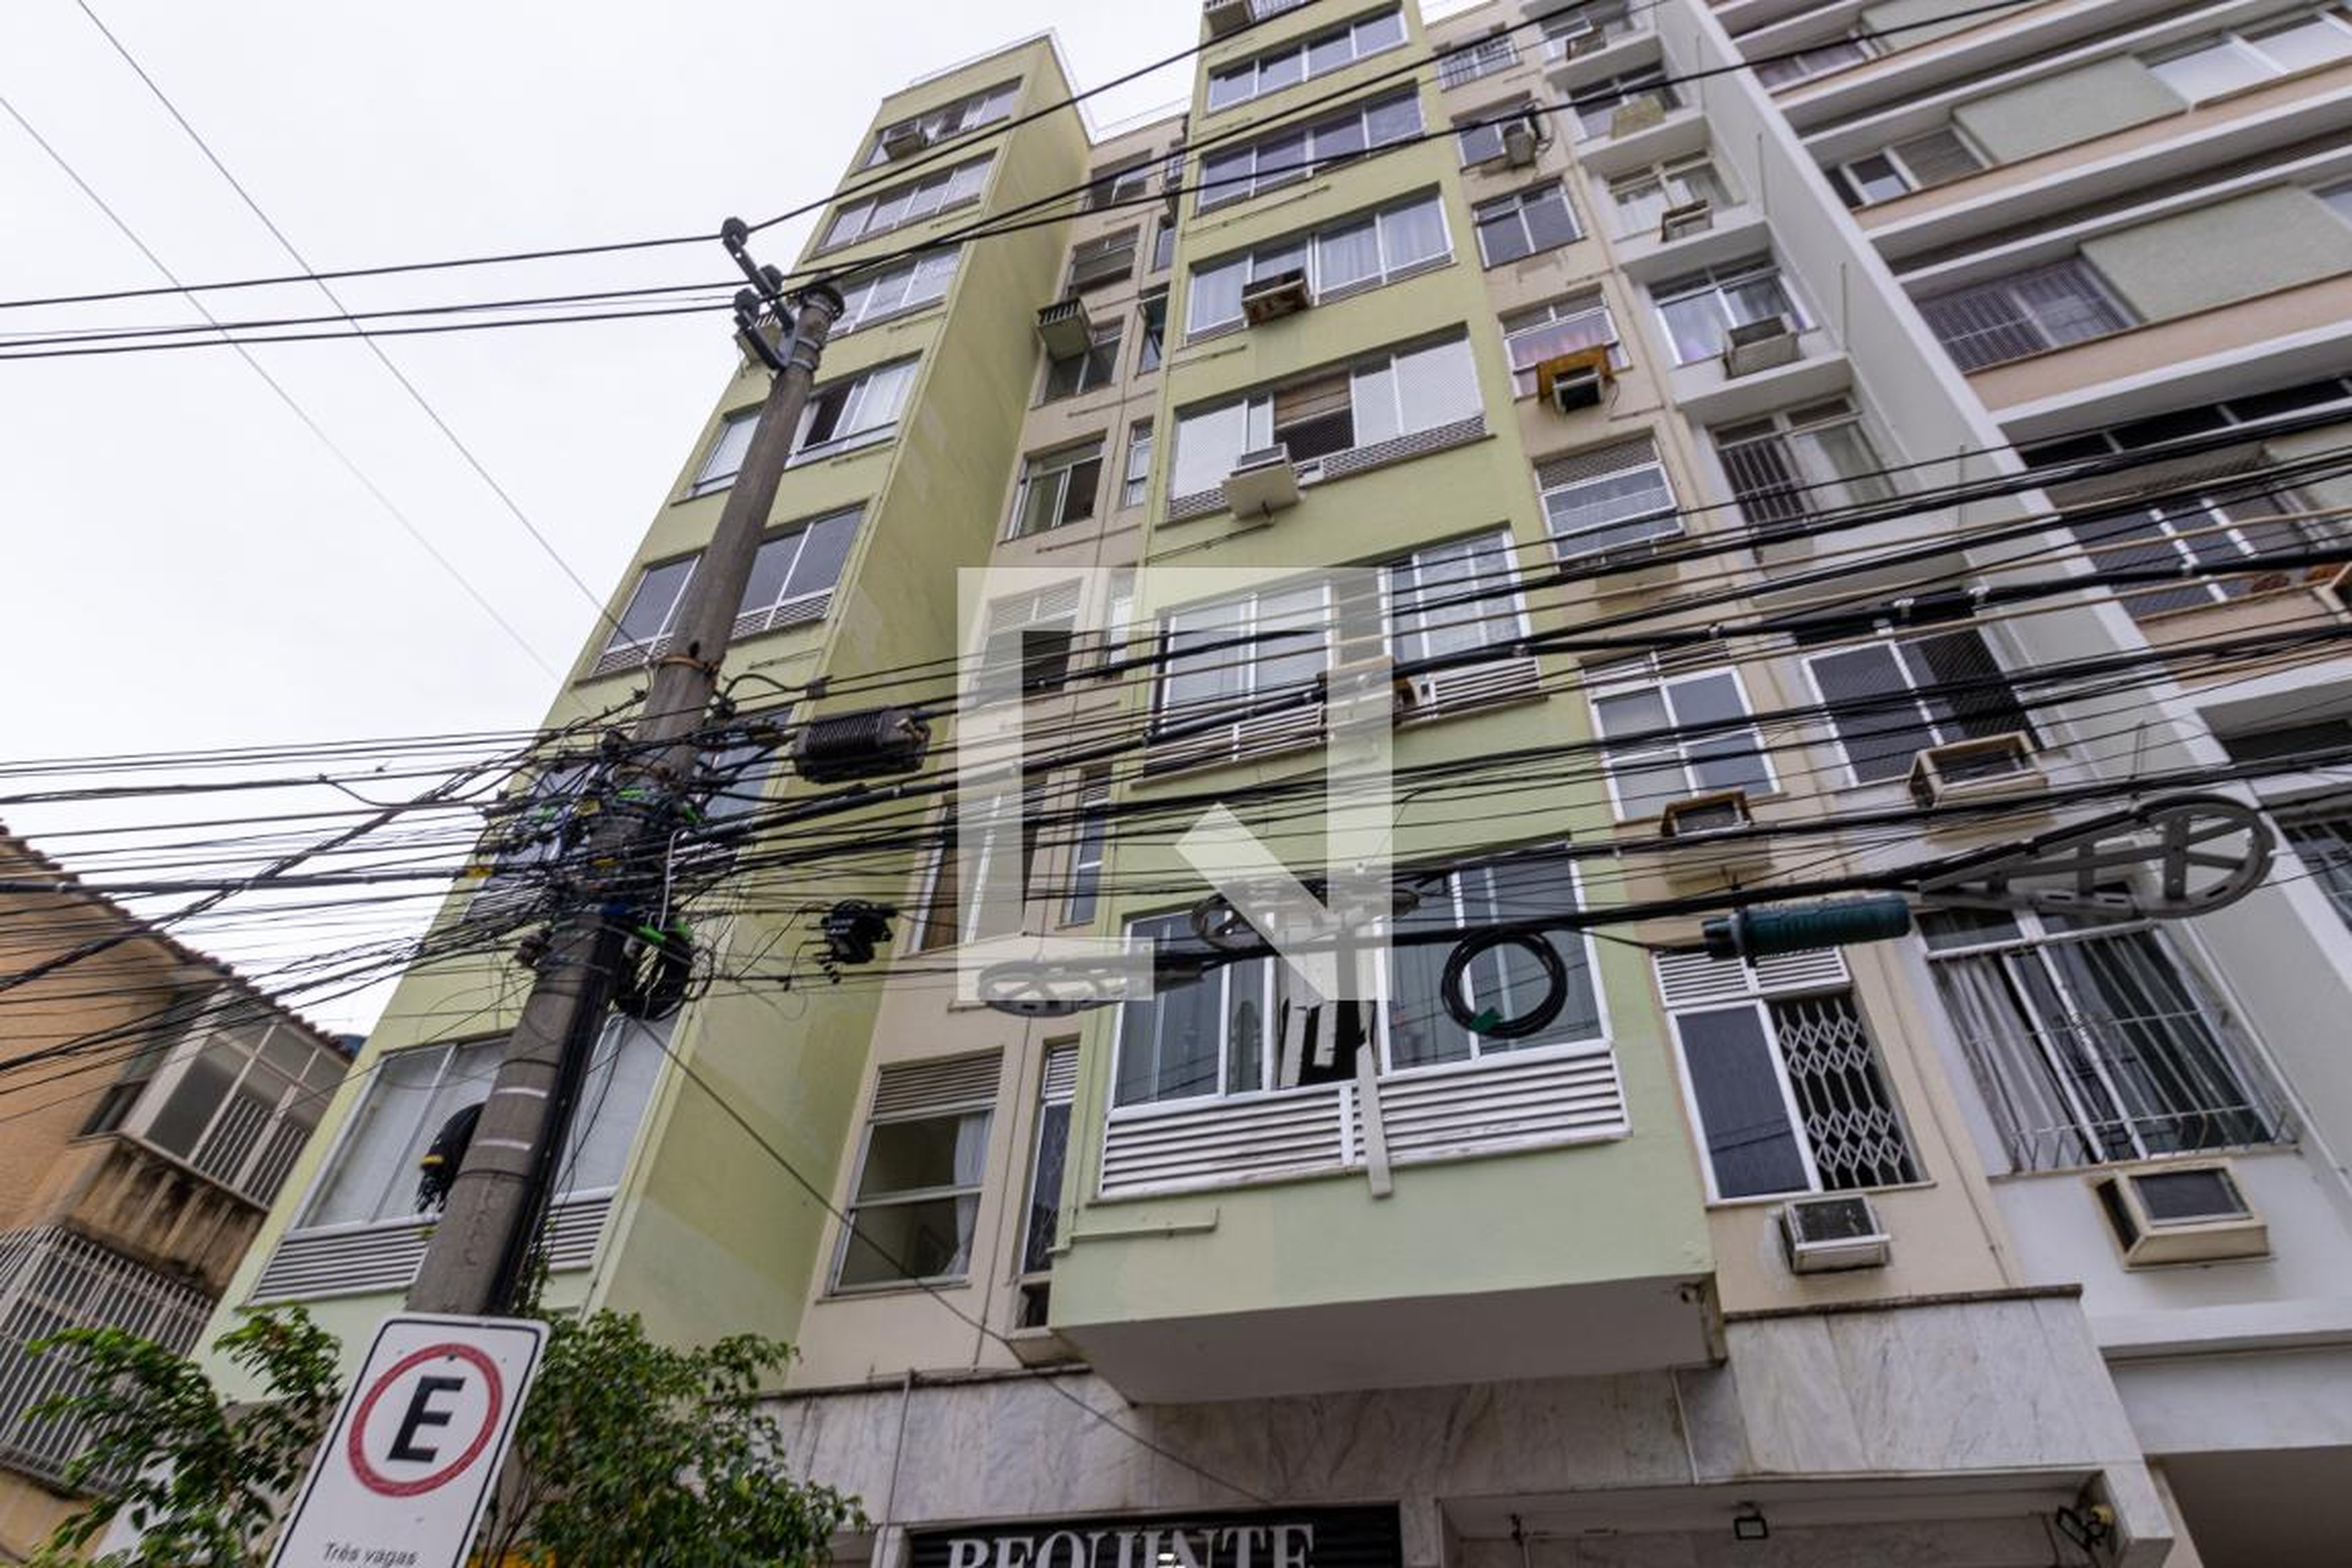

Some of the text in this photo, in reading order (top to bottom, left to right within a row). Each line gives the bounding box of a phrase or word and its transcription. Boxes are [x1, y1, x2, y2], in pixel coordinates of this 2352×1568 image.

[387, 1376, 466, 1462] E
[324, 1542, 418, 1568] Três vagas
